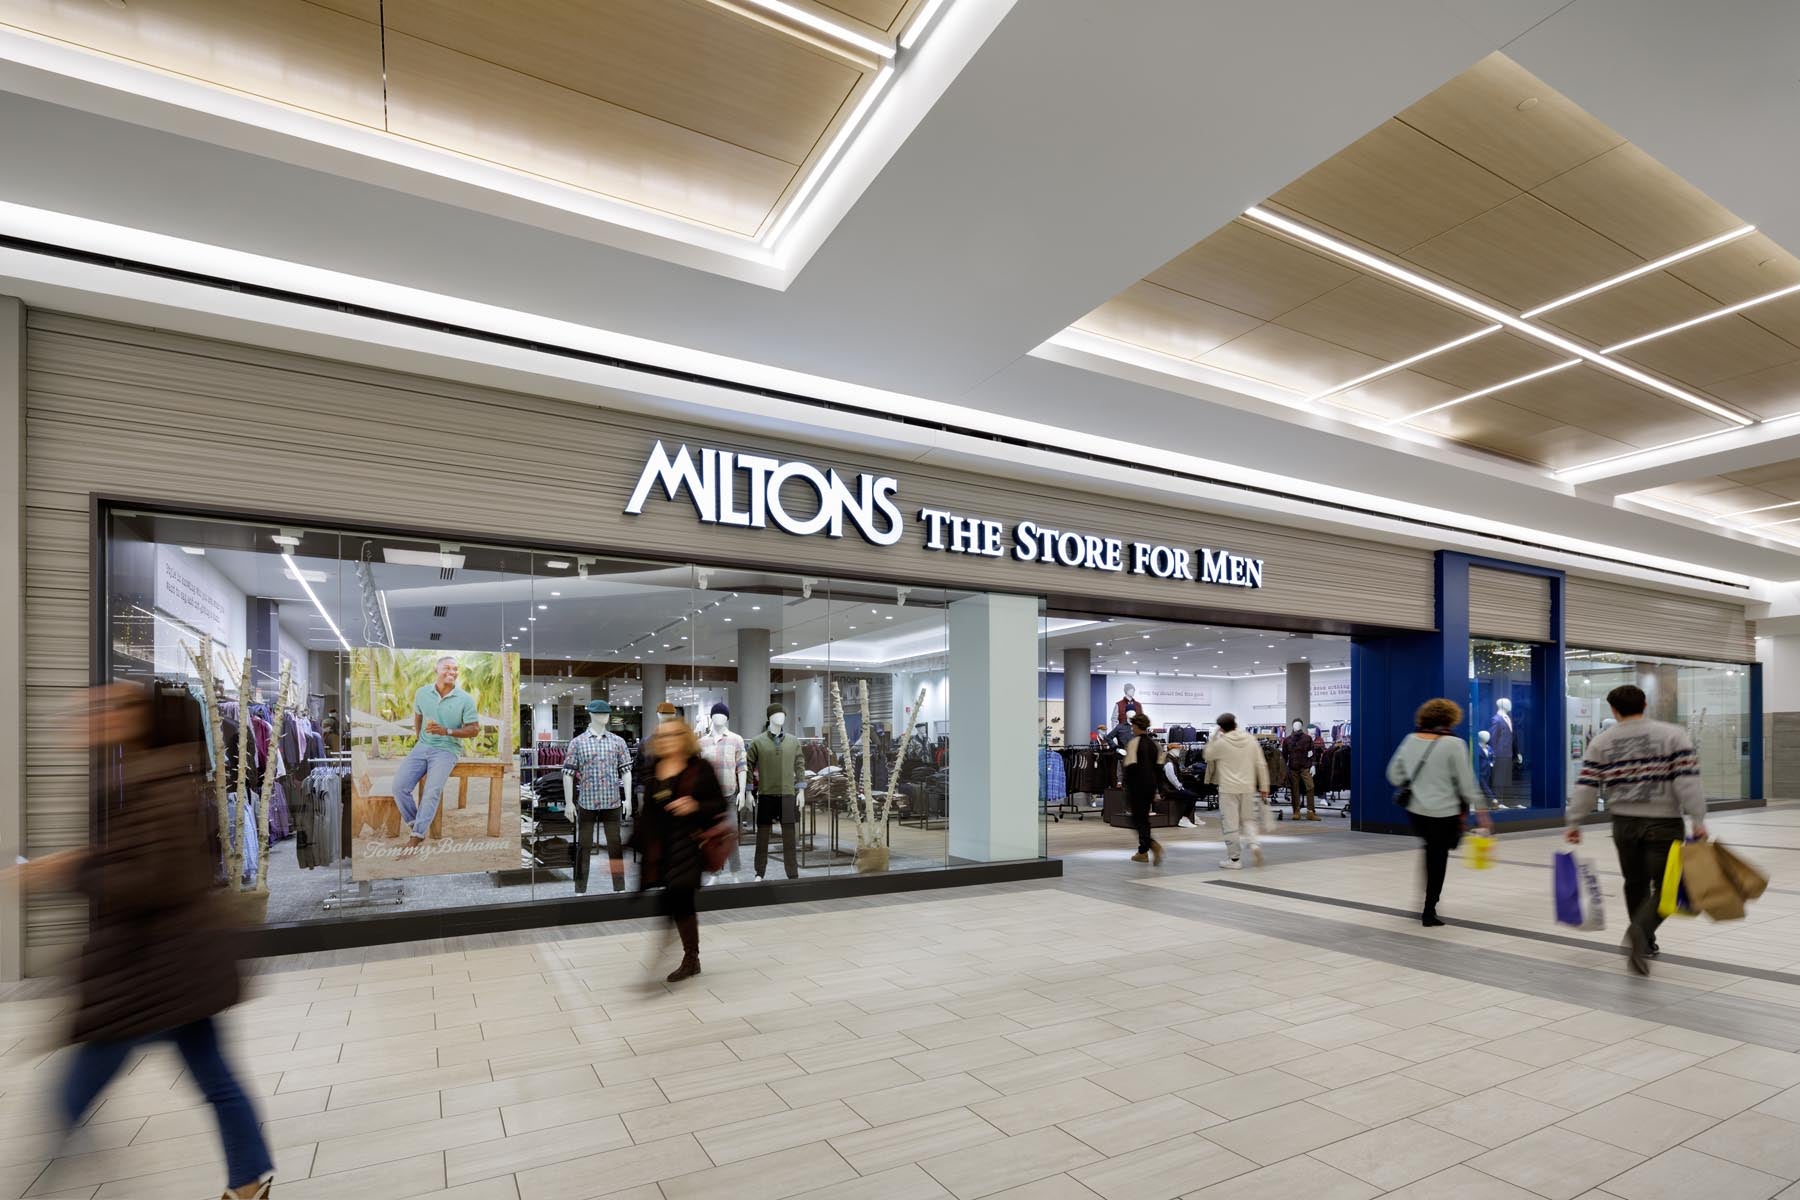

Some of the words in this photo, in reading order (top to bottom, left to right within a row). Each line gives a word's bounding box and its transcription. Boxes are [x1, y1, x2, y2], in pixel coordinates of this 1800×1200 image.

[625, 440, 904, 545] MILTONS
[921, 508, 1004, 557] THE
[1015, 521, 1123, 571] STORE
[1133, 542, 1193, 580] FOR
[1201, 547, 1265, 588] MEN
[364, 841, 434, 860] Tommy
[434, 838, 510, 854] Bahama
